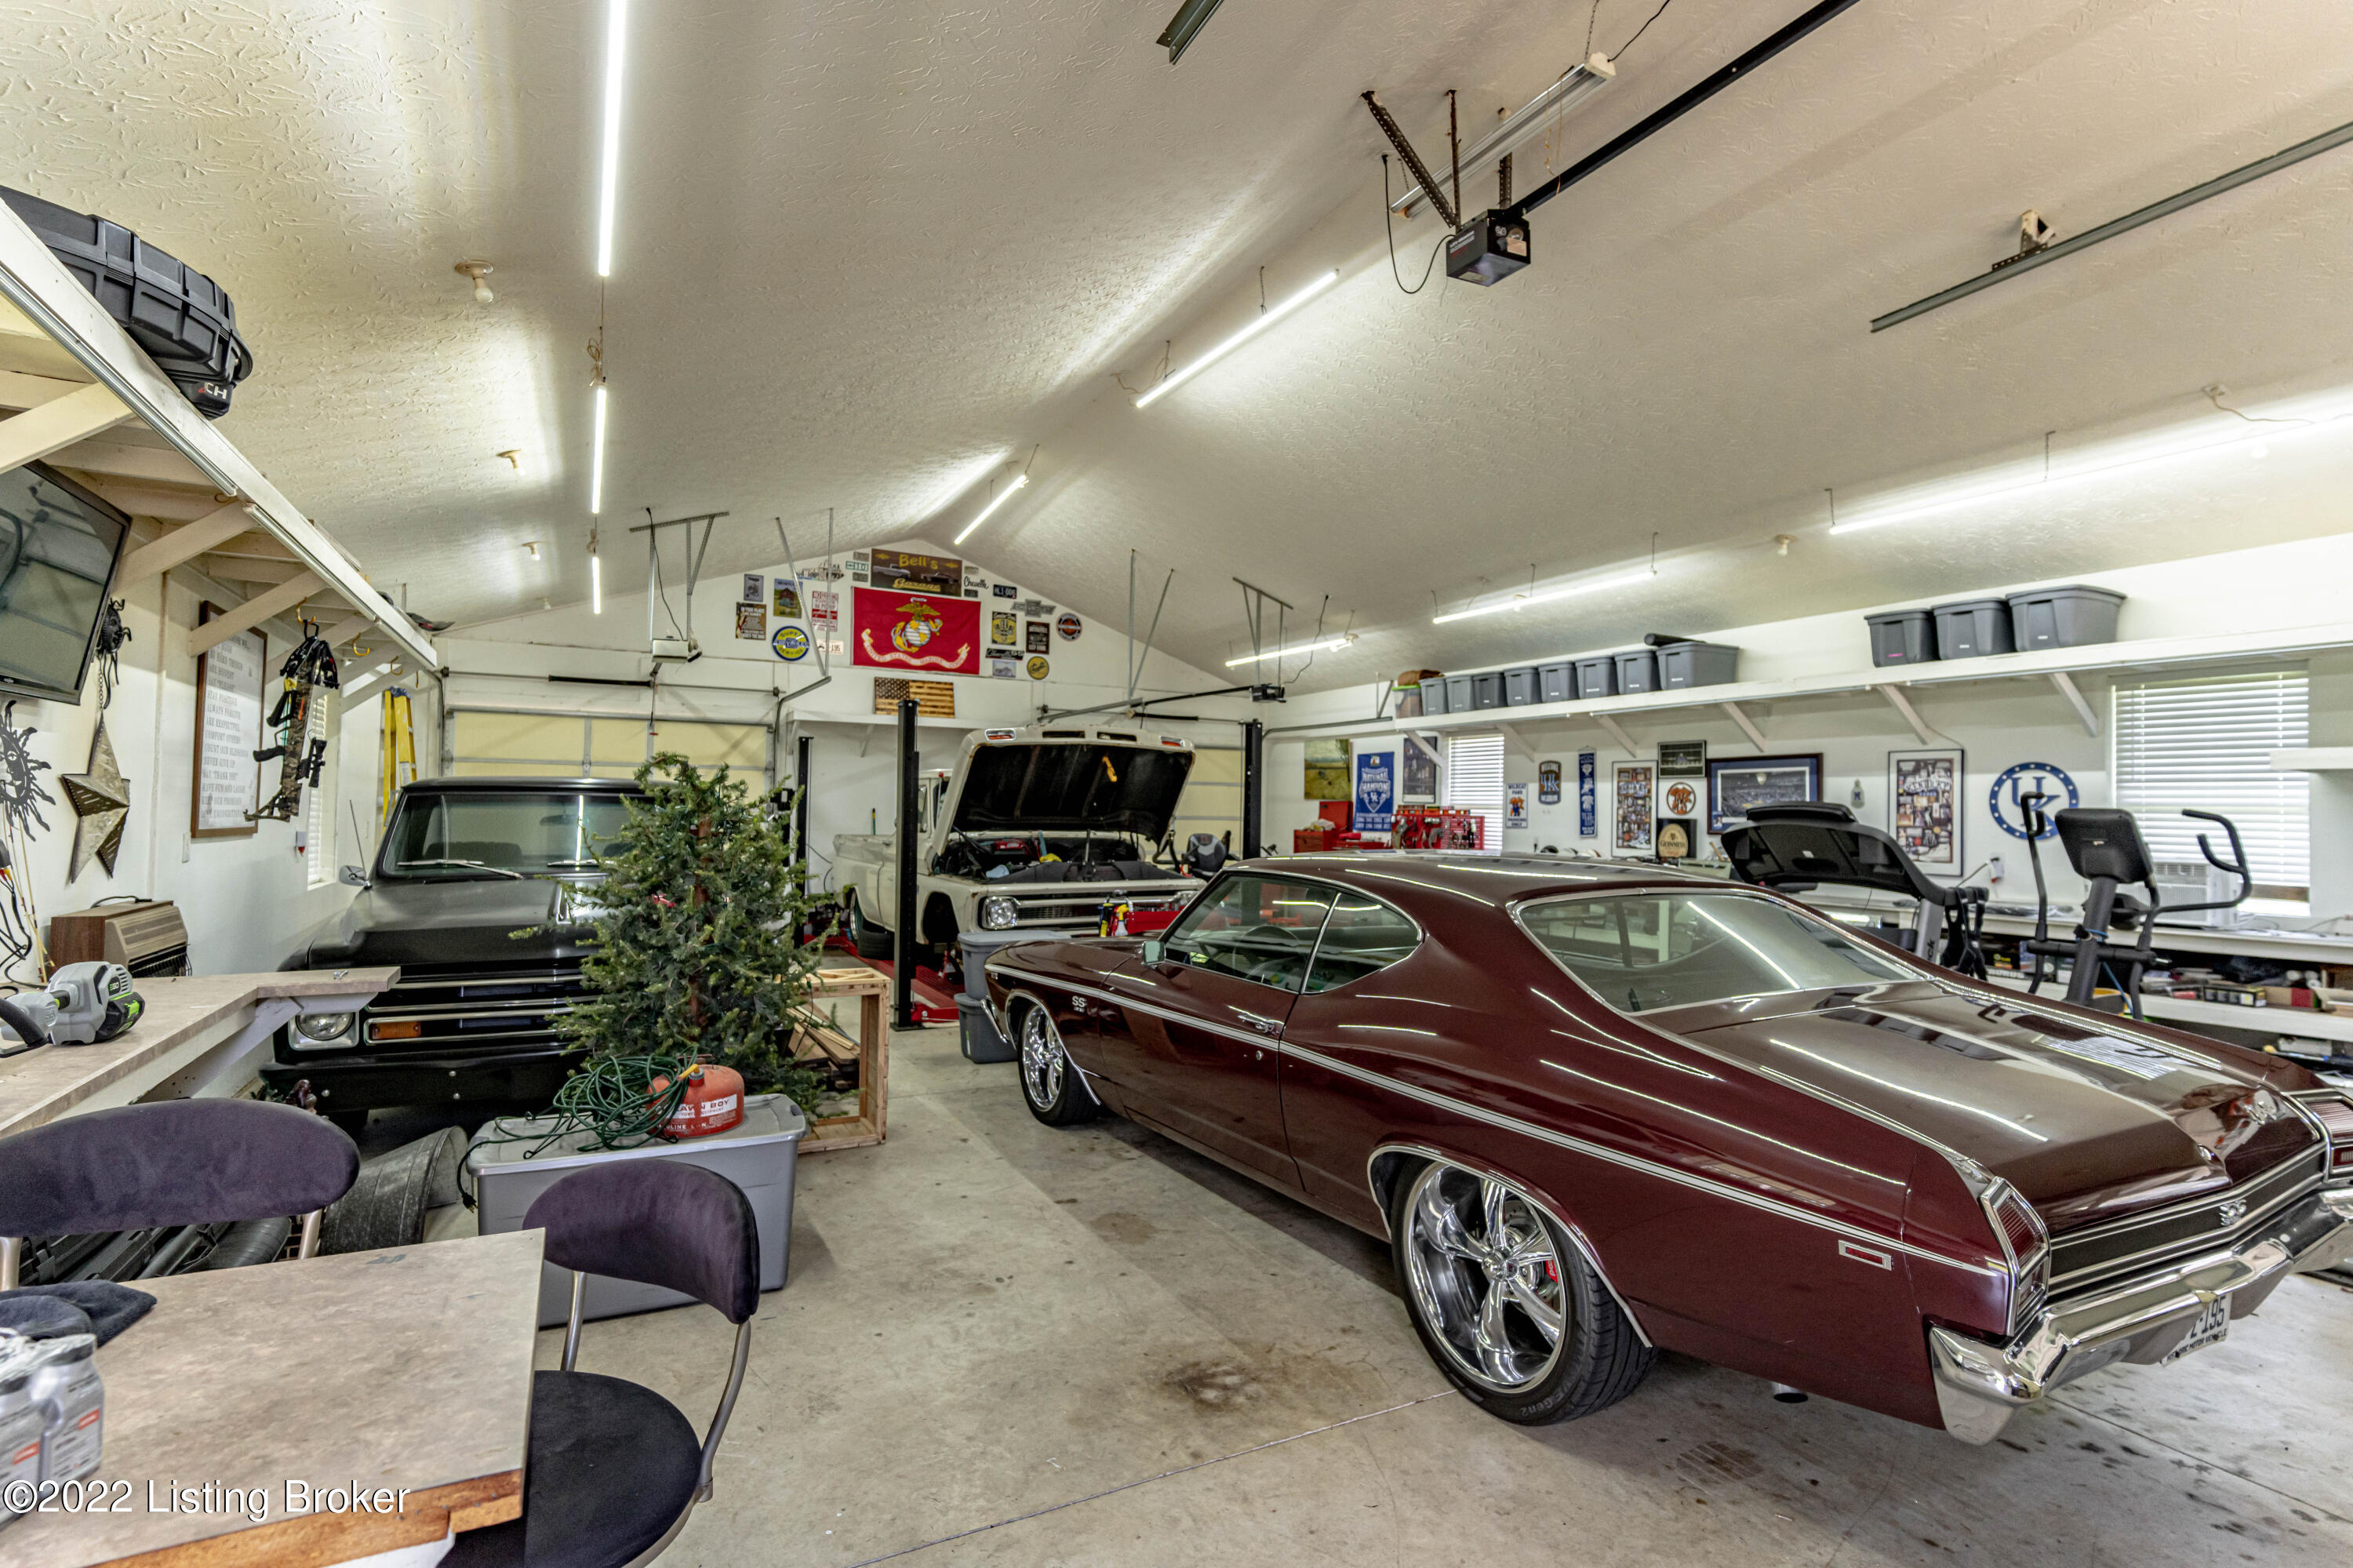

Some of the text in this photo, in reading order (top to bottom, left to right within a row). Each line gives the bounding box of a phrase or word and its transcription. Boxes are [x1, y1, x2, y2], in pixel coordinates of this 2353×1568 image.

[899, 553, 938, 570] Bell's
[218, 667, 234, 680] HONEST
[207, 704, 241, 721] ALWAYS FORGIVE
[216, 719, 240, 733] RESPECTFUL
[205, 729, 241, 744] COMFORT OTHERS
[204, 743, 220, 754] COUNT
[220, 746, 228, 755] OUR
[203, 756, 235, 769] NEVER GIVE UP
[202, 783, 214, 792] HAVE
[215, 783, 224, 792] FUN
[1540, 773, 1560, 791] UK
[213, 796, 223, 806] OUR
[2009, 776, 2061, 827] UK
[108, 981, 119, 991] EGO
[1072, 995, 1086, 1008] SS
[710, 1098, 729, 1108] BOY
[2188, 1337, 2205, 1349] MOTOR
[1520, 1397, 1553, 1417] Gen2
